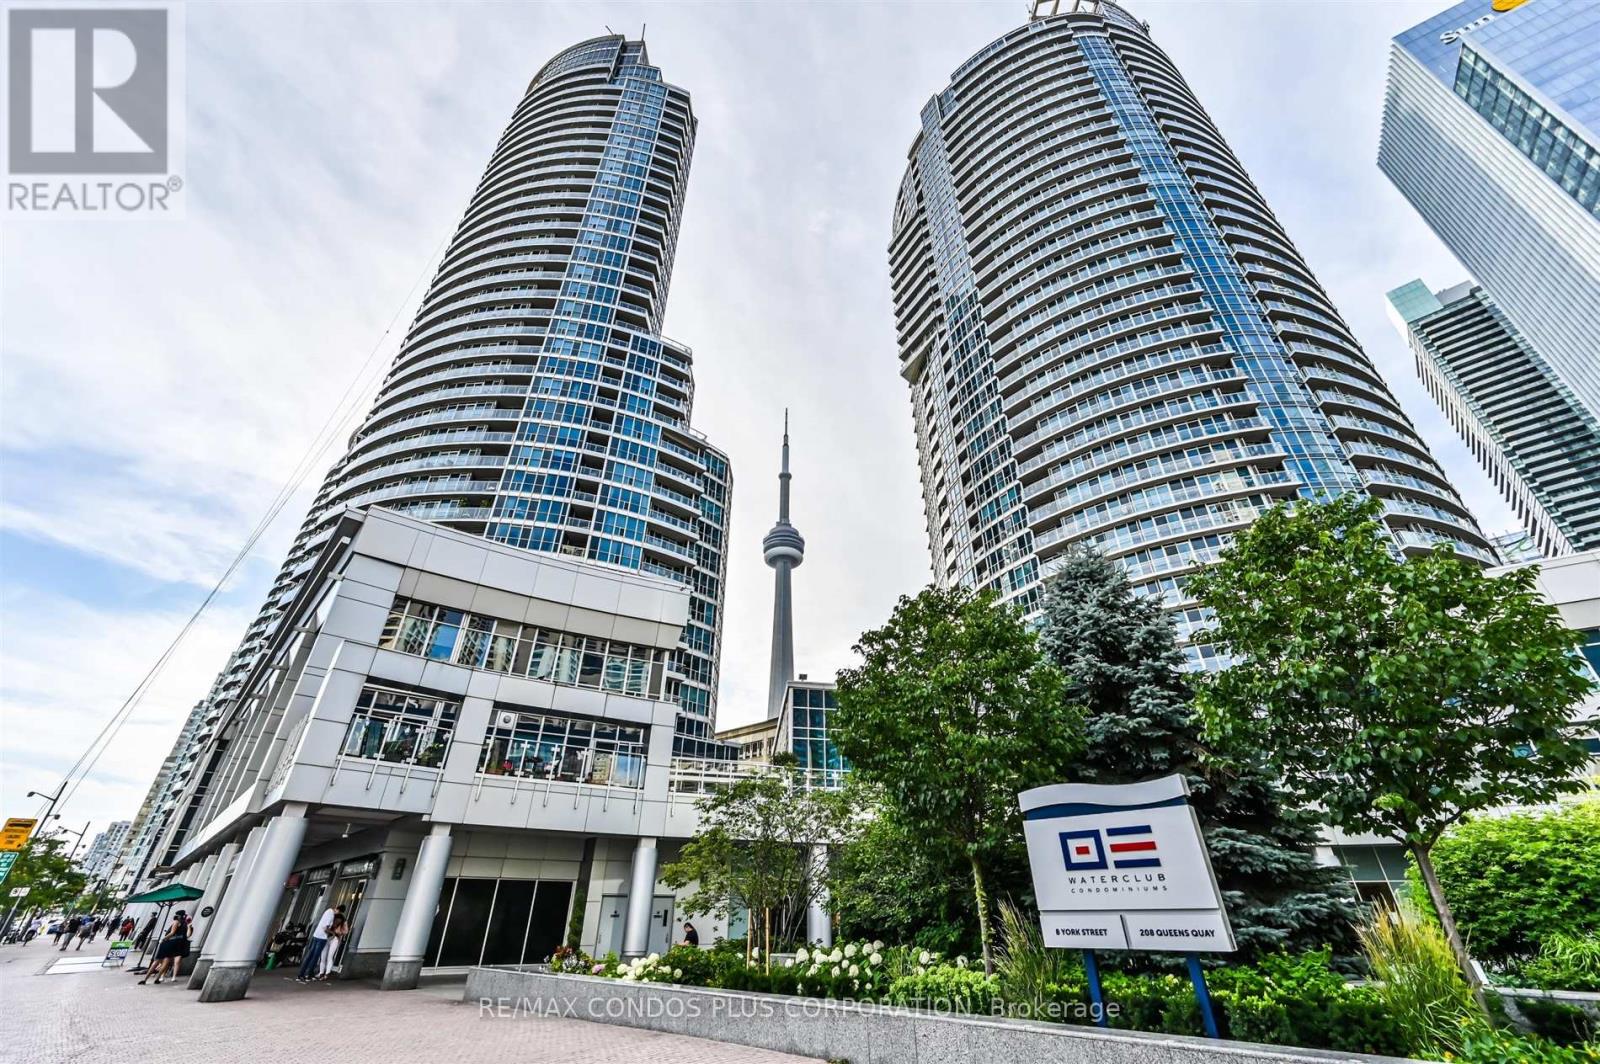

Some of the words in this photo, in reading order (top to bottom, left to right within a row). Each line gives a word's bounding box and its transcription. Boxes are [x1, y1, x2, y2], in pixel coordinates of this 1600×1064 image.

[1068, 873, 1166, 885] WATERCLUB
[1071, 885, 1167, 894] CONDOMINIUMS
[1061, 928, 1081, 936] YORK
[1081, 928, 1108, 937] STREET
[1139, 929, 1155, 937] 208
[1156, 929, 1190, 938] QUEENS
[1190, 929, 1215, 938] QUAY
